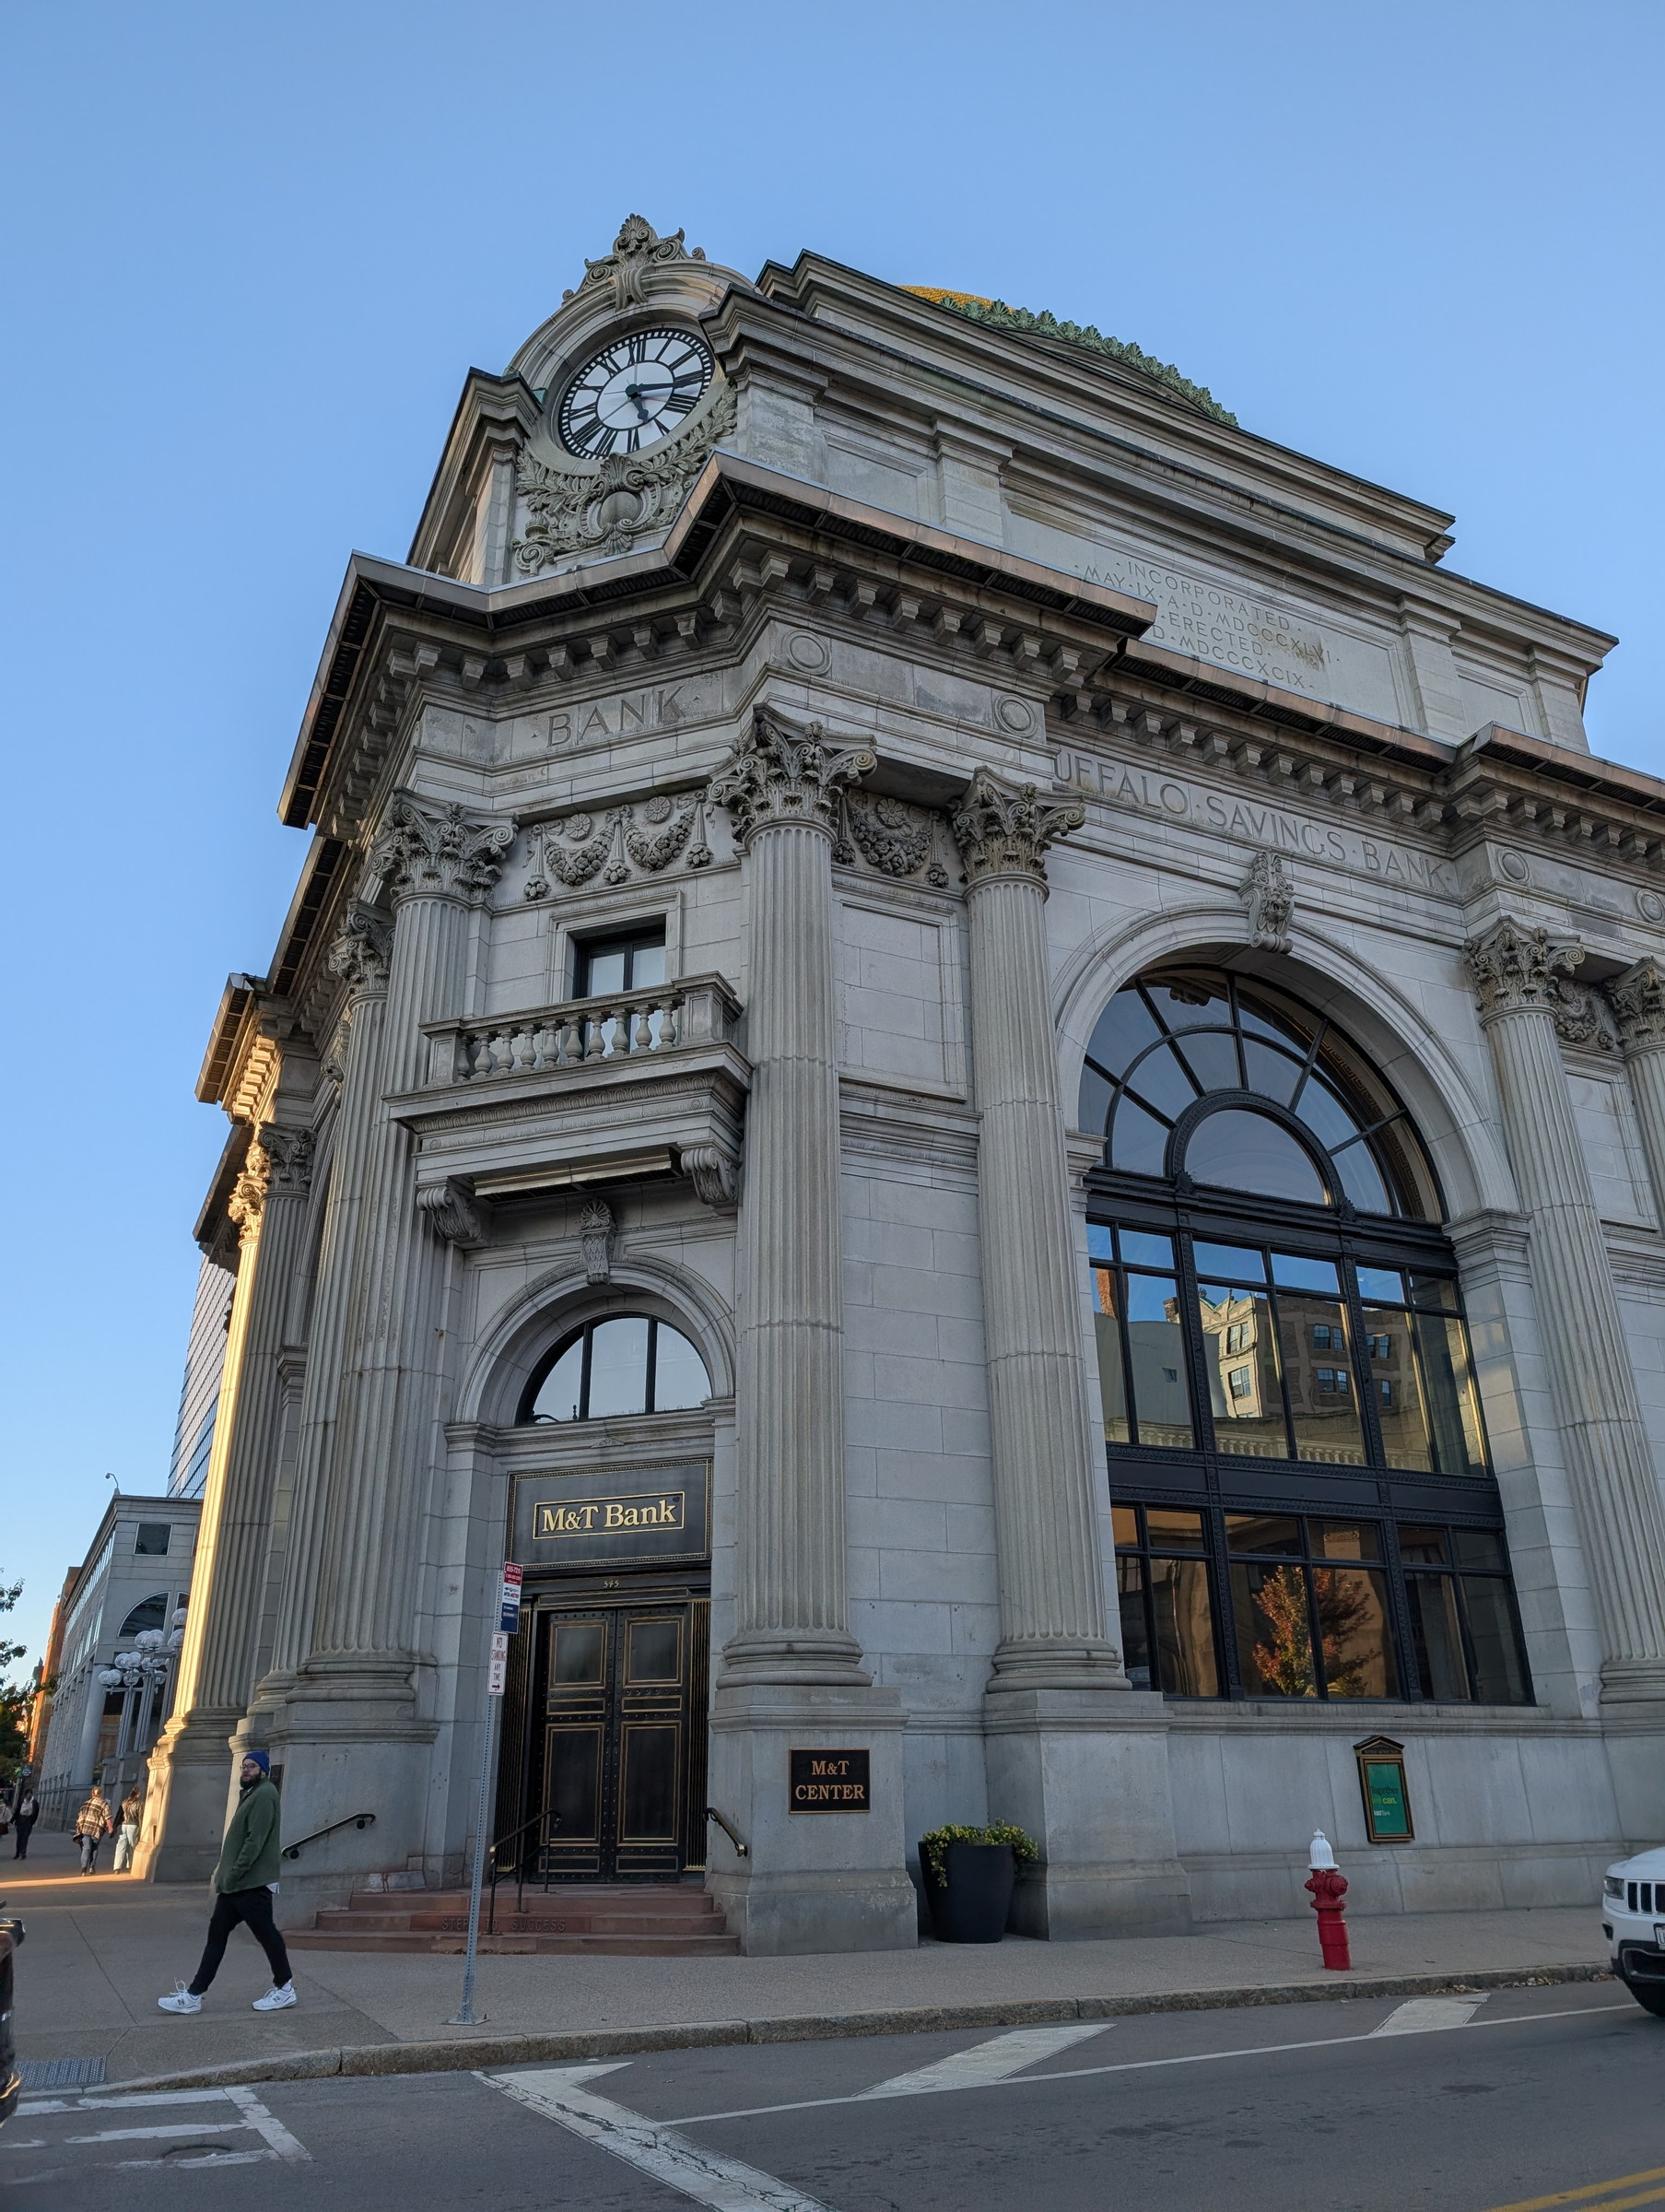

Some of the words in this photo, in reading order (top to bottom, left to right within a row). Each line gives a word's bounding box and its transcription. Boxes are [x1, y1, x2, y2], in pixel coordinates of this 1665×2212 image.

[1085, 565, 1125, 588] MAY
[1136, 582, 1155, 600] IX
[1167, 595, 1179, 609] A
[1191, 602, 1202, 617] D
[1216, 613, 1332, 664] MDCCCXLVI
[1128, 560, 1290, 630] INCORPORATED
[1168, 612, 1263, 656] ERECTED
[1153, 624, 1165, 640] D
[1179, 636, 1306, 688] MDCCCXCIX
[547, 685, 686, 748] BANK
[1053, 752, 1189, 815] UFFALO
[1207, 794, 1348, 862] SAVINGS
[1361, 840, 1444, 892] BANK
[541, 1505, 599, 1533] M&T
[604, 1499, 677, 1528] Bank
[496, 1637, 503, 1648] NO
[811, 1760, 850, 1775] M&T
[795, 1784, 865, 1800] CENTER
[1371, 1786, 1399, 1796] Together
[511, 1918, 566, 1932] SUCCESS
